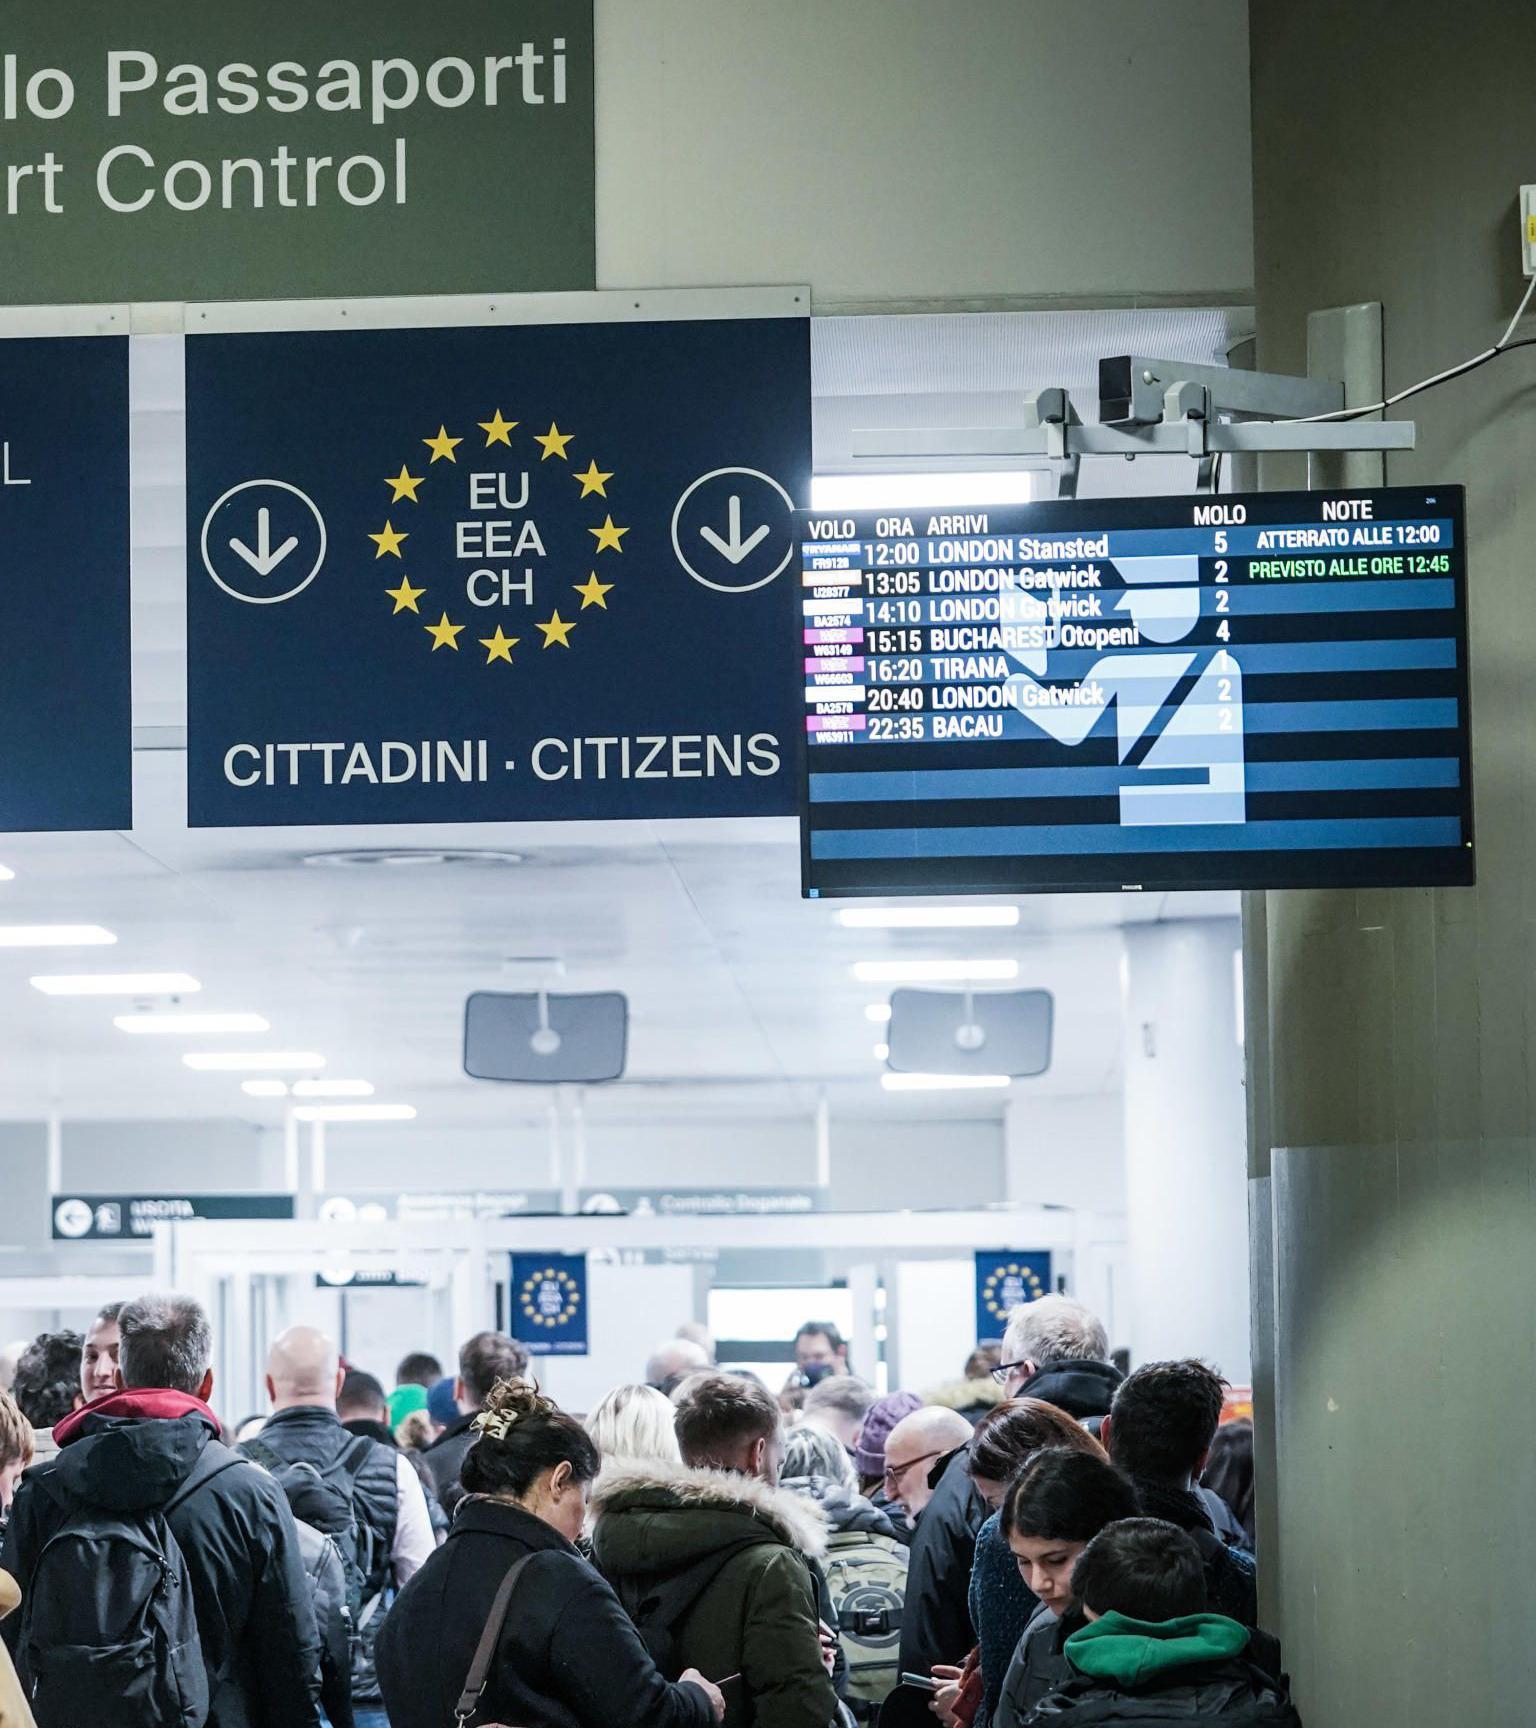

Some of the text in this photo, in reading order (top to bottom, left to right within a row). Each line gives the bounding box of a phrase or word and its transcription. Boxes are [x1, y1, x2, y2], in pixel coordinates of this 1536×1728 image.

[107, 37, 567, 125] Passaporti
[96, 137, 406, 213] Control
[469, 471, 529, 510] EU
[808, 499, 1374, 540] VOLO ORA ARRIVI MOLO NOTE
[456, 519, 547, 559] EEA
[865, 534, 1108, 564] 12:00 LONDON Stansted
[1214, 525, 1440, 553] 5 ATTERRATO ALLE 12:00
[866, 565, 1101, 593] 13:05 LONDON Gatwick
[1215, 555, 1450, 583] 2 PREVISTO ALLE ORE 12:45
[466, 568, 533, 607] CH
[1216, 591, 1229, 612] 2
[866, 594, 1102, 622] 14:10 LONDON Gatwick
[867, 630, 922, 652] 15:15
[931, 626, 1057, 651] BUCHAREST
[1061, 625, 1139, 651] Otopeni
[1216, 620, 1229, 642] 4
[868, 659, 922, 681] 16:20
[931, 656, 1009, 679] TIRANA
[1219, 650, 1228, 671] 1
[868, 682, 1104, 710] 20:40 LONDON Gatwick
[1218, 680, 1231, 700] 2
[869, 717, 924, 740] 22:35
[932, 715, 1003, 738] BACAU
[1219, 709, 1232, 730] 2
[223, 739, 488, 787] CITTADINI
[531, 732, 781, 781] CITIZENS
